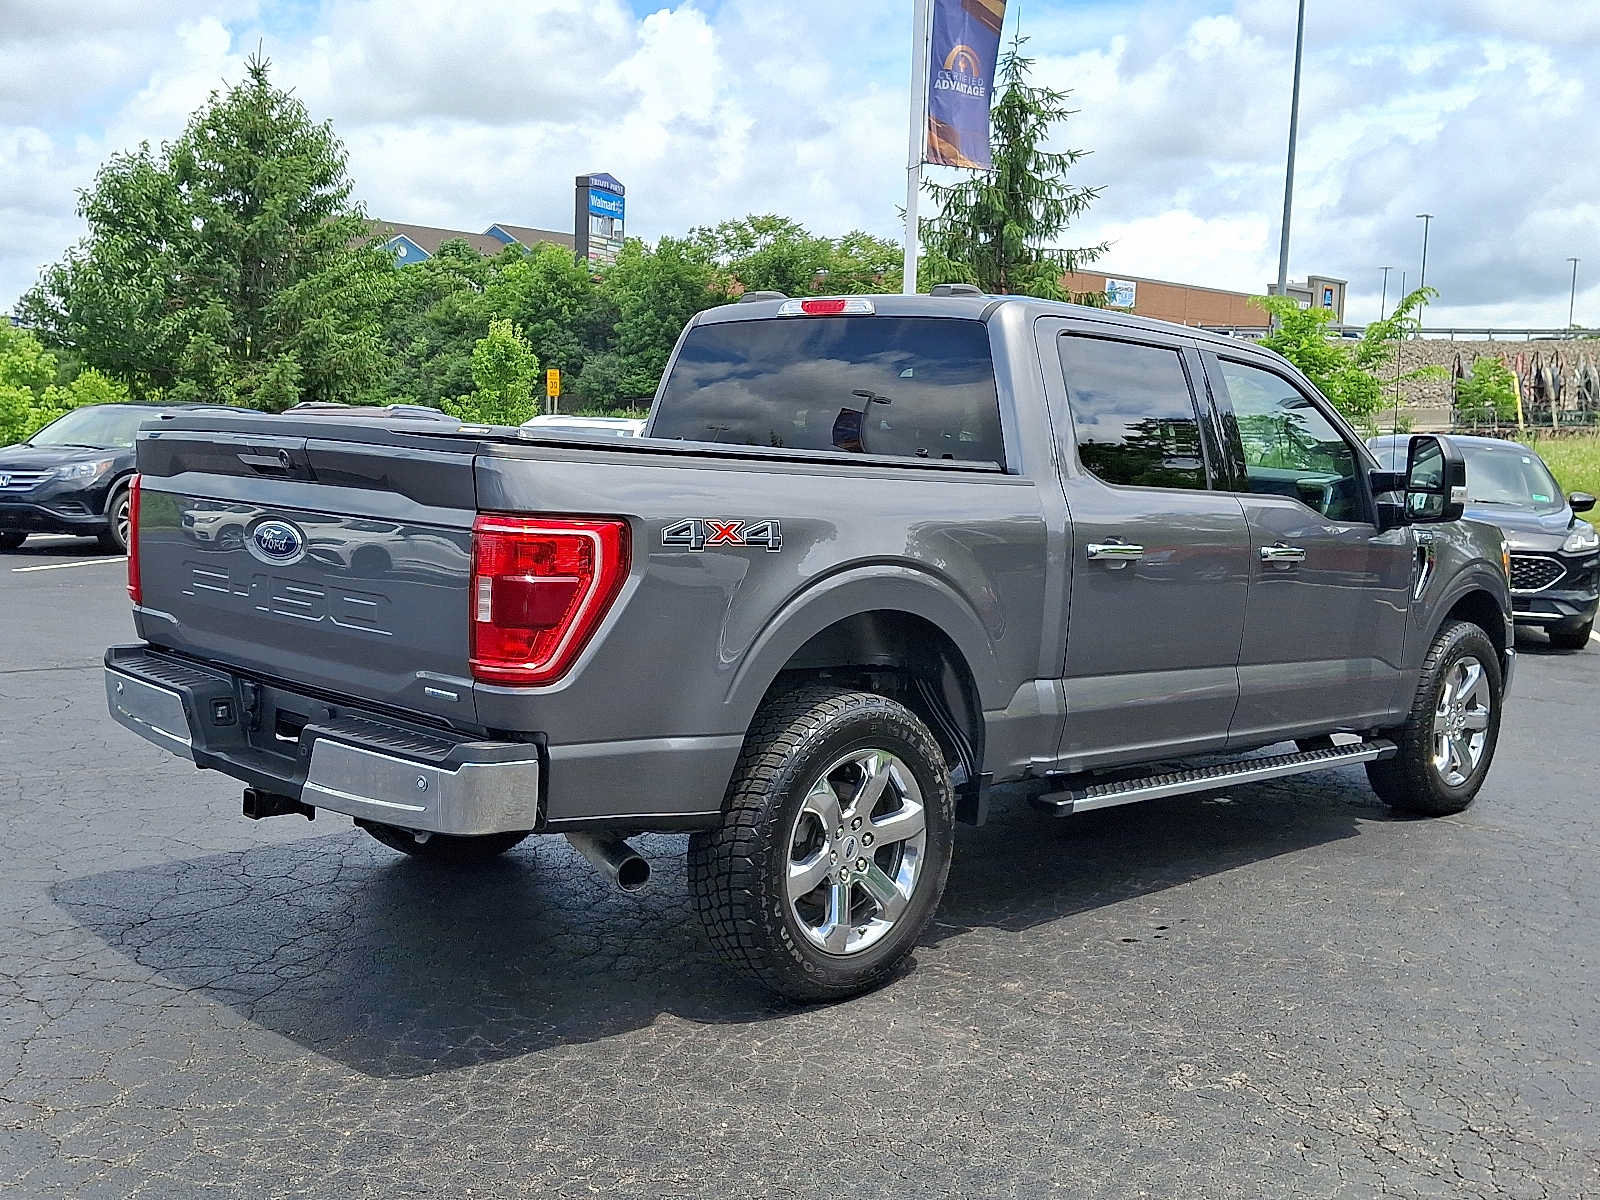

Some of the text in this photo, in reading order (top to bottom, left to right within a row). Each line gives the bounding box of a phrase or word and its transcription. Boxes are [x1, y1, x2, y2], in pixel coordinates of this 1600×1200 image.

[937, 71, 984, 87] CERTIFIED
[591, 195, 616, 212] Walmart
[261, 528, 288, 551] Ford
[182, 561, 393, 635] F-150
